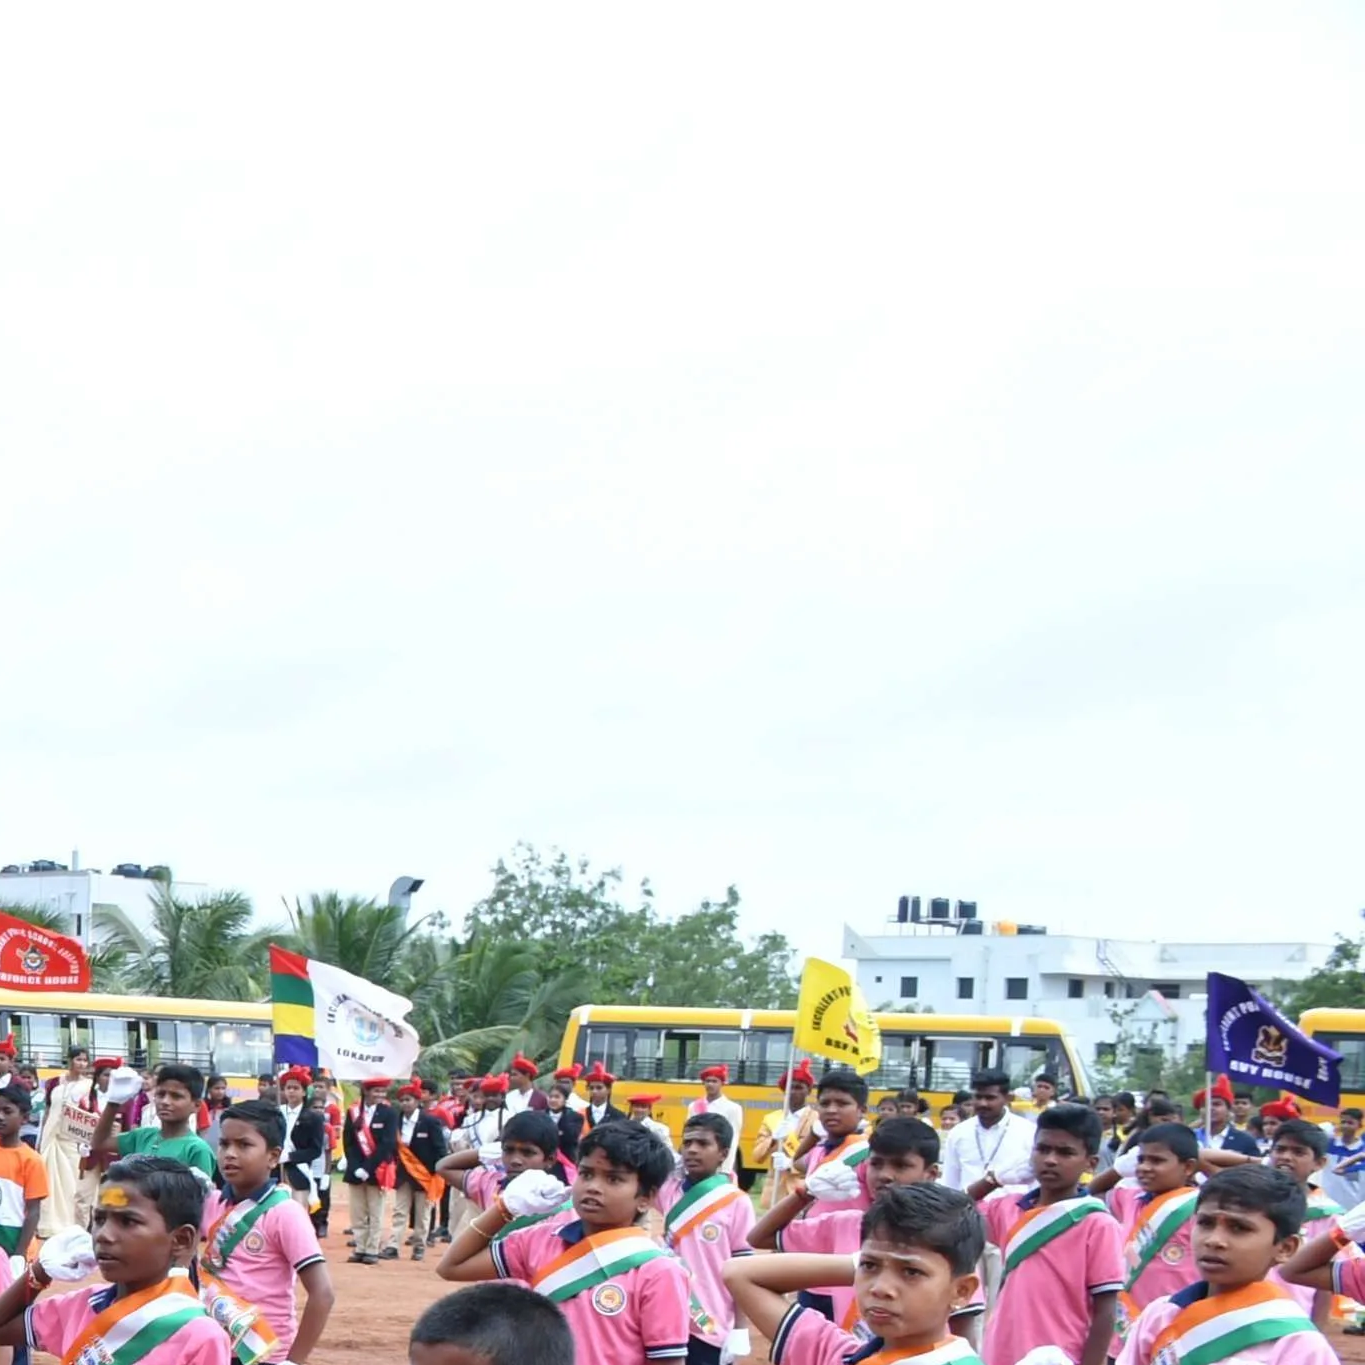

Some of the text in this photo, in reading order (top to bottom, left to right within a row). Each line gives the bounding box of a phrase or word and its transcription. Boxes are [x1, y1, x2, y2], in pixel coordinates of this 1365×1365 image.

[44, 976, 79, 985] HOUSE
[337, 1048, 385, 1063] LOKAPUR
[1261, 1067, 1312, 1089] HOUSE
[64, 1107, 98, 1127] AIRFO
[68, 1124, 93, 1138] HOUS
